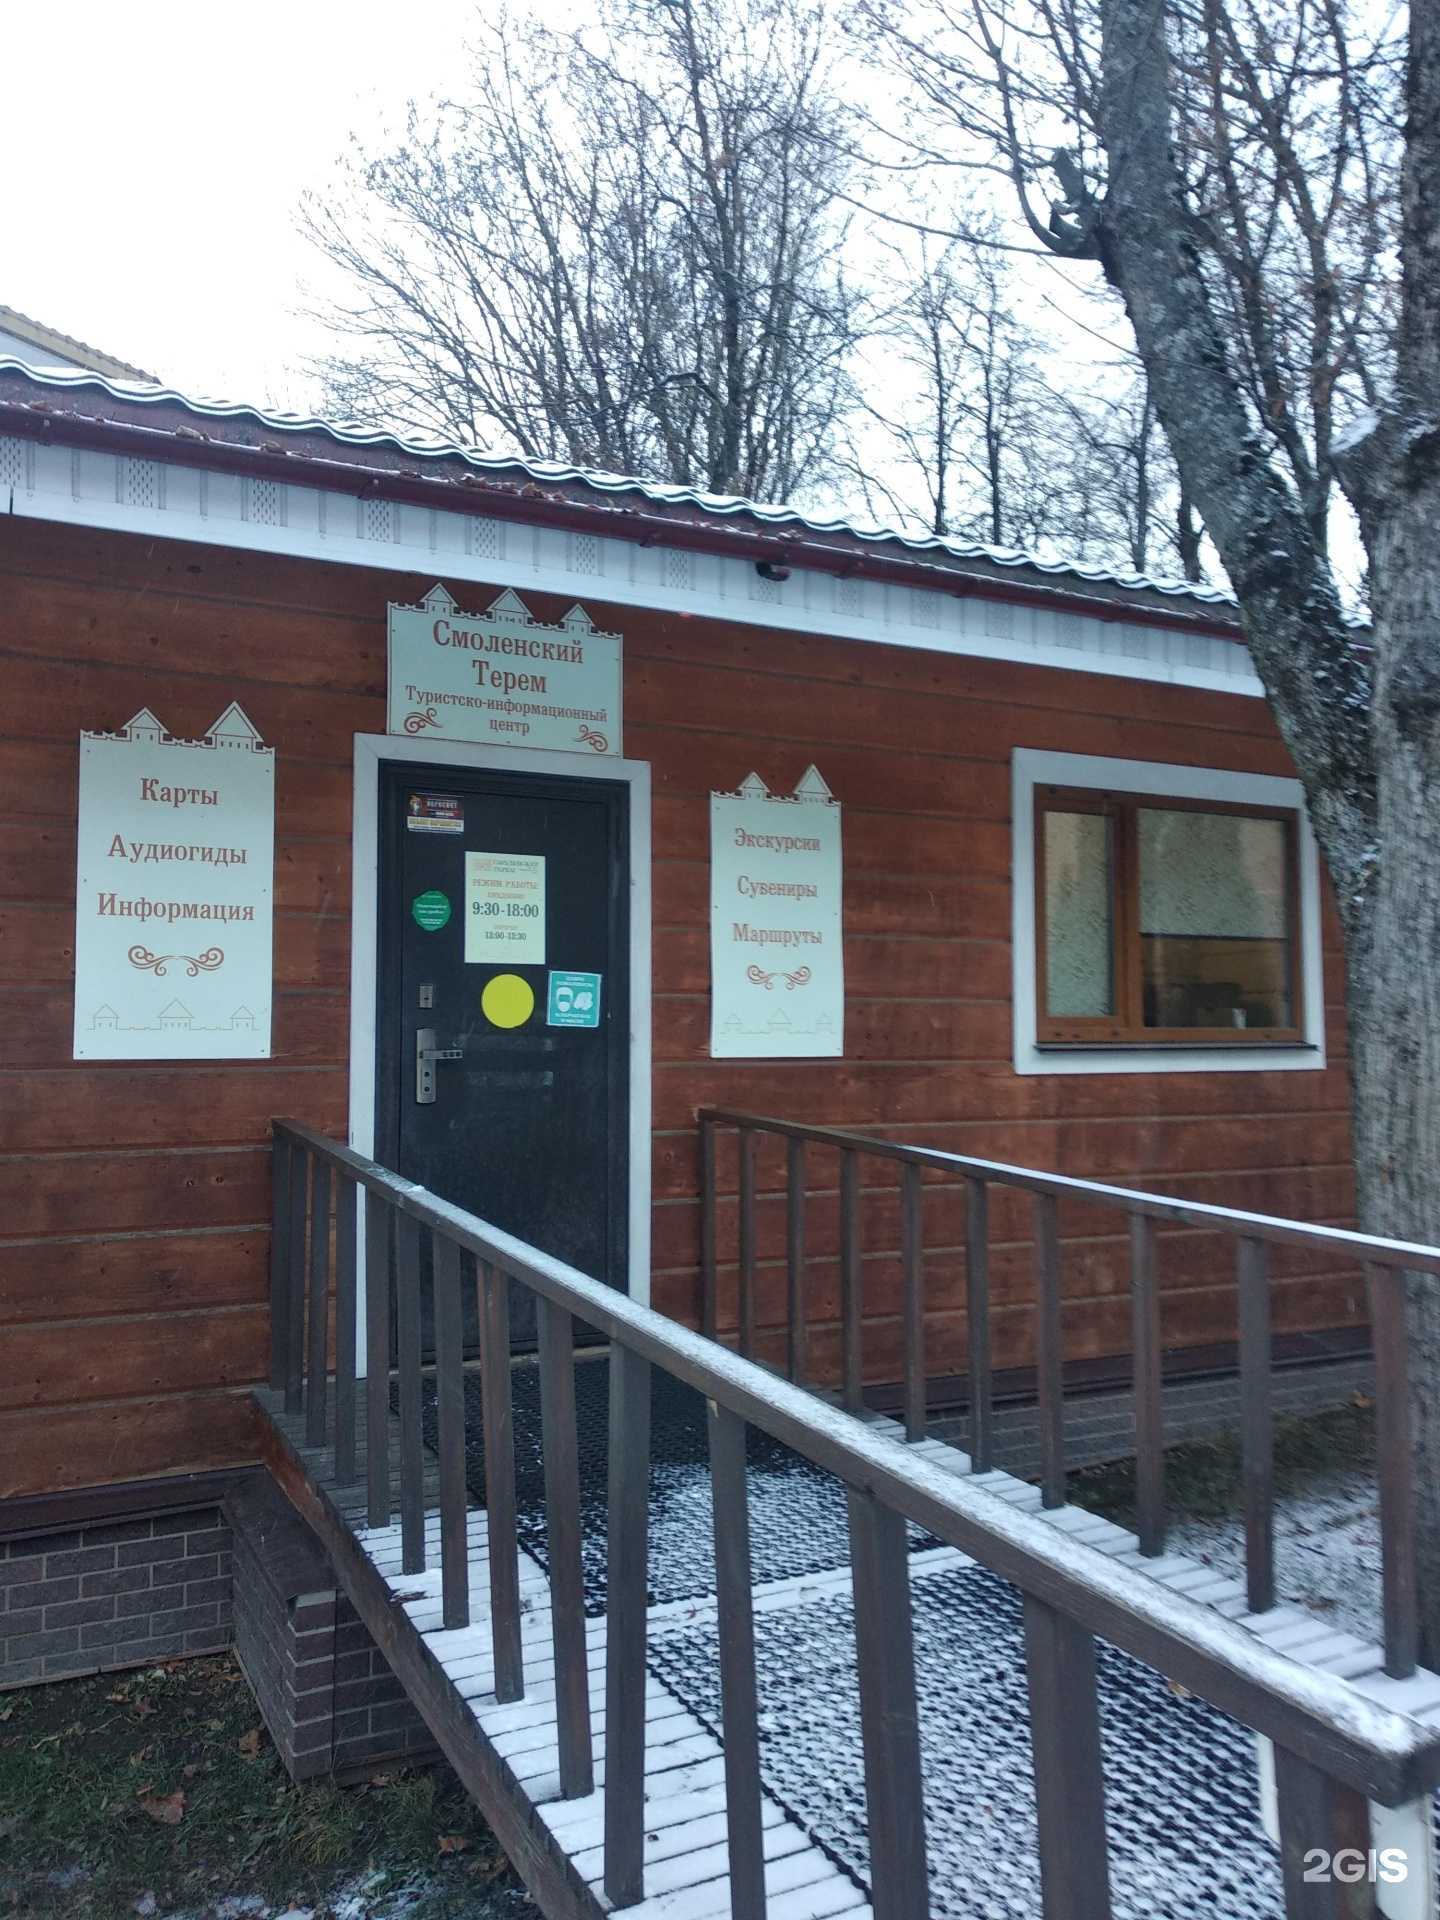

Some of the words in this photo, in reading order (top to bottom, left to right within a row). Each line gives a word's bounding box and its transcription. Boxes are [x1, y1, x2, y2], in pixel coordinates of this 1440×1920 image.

[433, 619, 583, 664] Смоленский
[472, 659, 548, 694] Терем
[405, 685, 607, 722] Туристско-информационный
[489, 718, 530, 736] центр
[140, 777, 219, 808] Карты
[107, 834, 248, 867] Аудиогиды
[734, 827, 821, 853] Экскурсии
[737, 875, 818, 900] Сувениры
[96, 893, 255, 923] Информация
[733, 923, 822, 947] Маршруты
